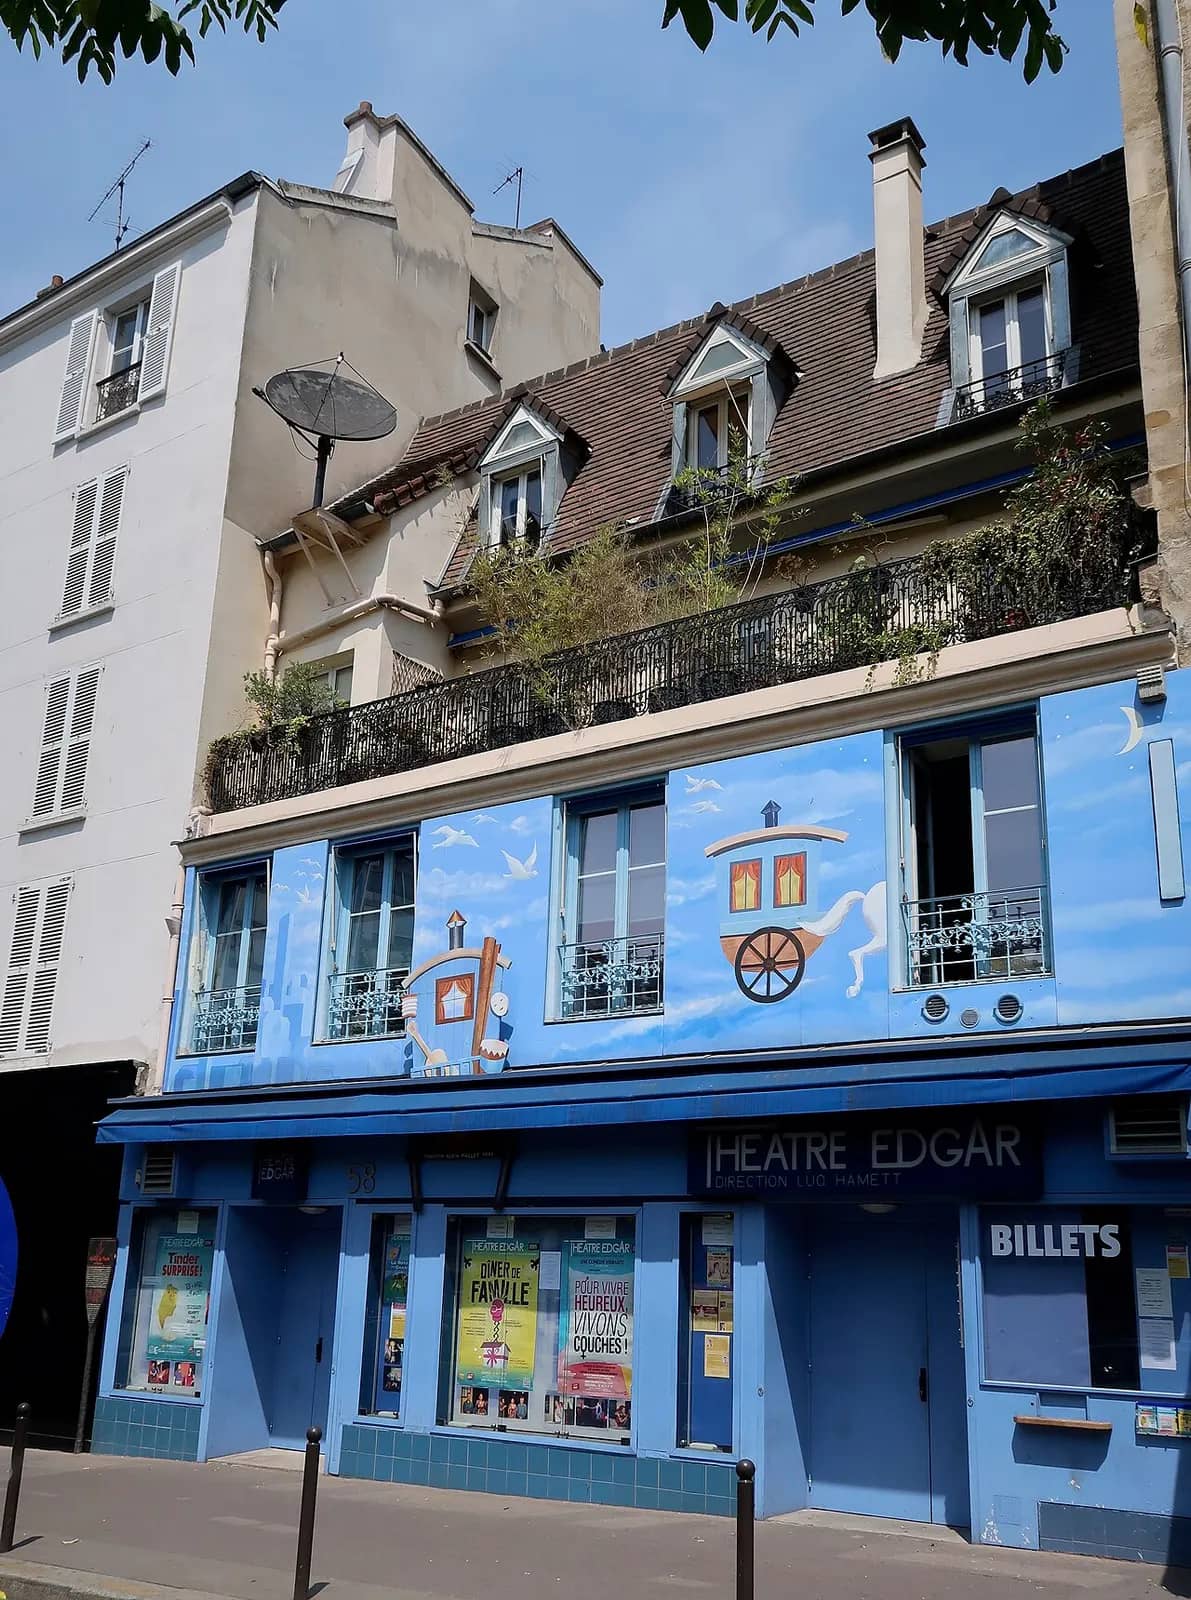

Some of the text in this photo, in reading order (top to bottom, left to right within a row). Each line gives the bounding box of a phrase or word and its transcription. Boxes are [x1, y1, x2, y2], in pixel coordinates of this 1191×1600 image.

[871, 1117, 1021, 1168] EDGAR
[344, 1160, 377, 1194] 58
[715, 1174, 788, 1188] DIRECTION
[835, 1172, 902, 1187] HAMETT
[499, 1240, 524, 1252] EDGAR
[601, 1241, 630, 1254] EDGAR
[991, 1224, 1121, 1257] BILLETS
[167, 1252, 200, 1265] Tinder
[511, 1267, 521, 1279] DE
[575, 1276, 630, 1296] POUR VIVRE
[575, 1295, 628, 1312] HEUREUX,
[573, 1312, 628, 1337] VIVONS
